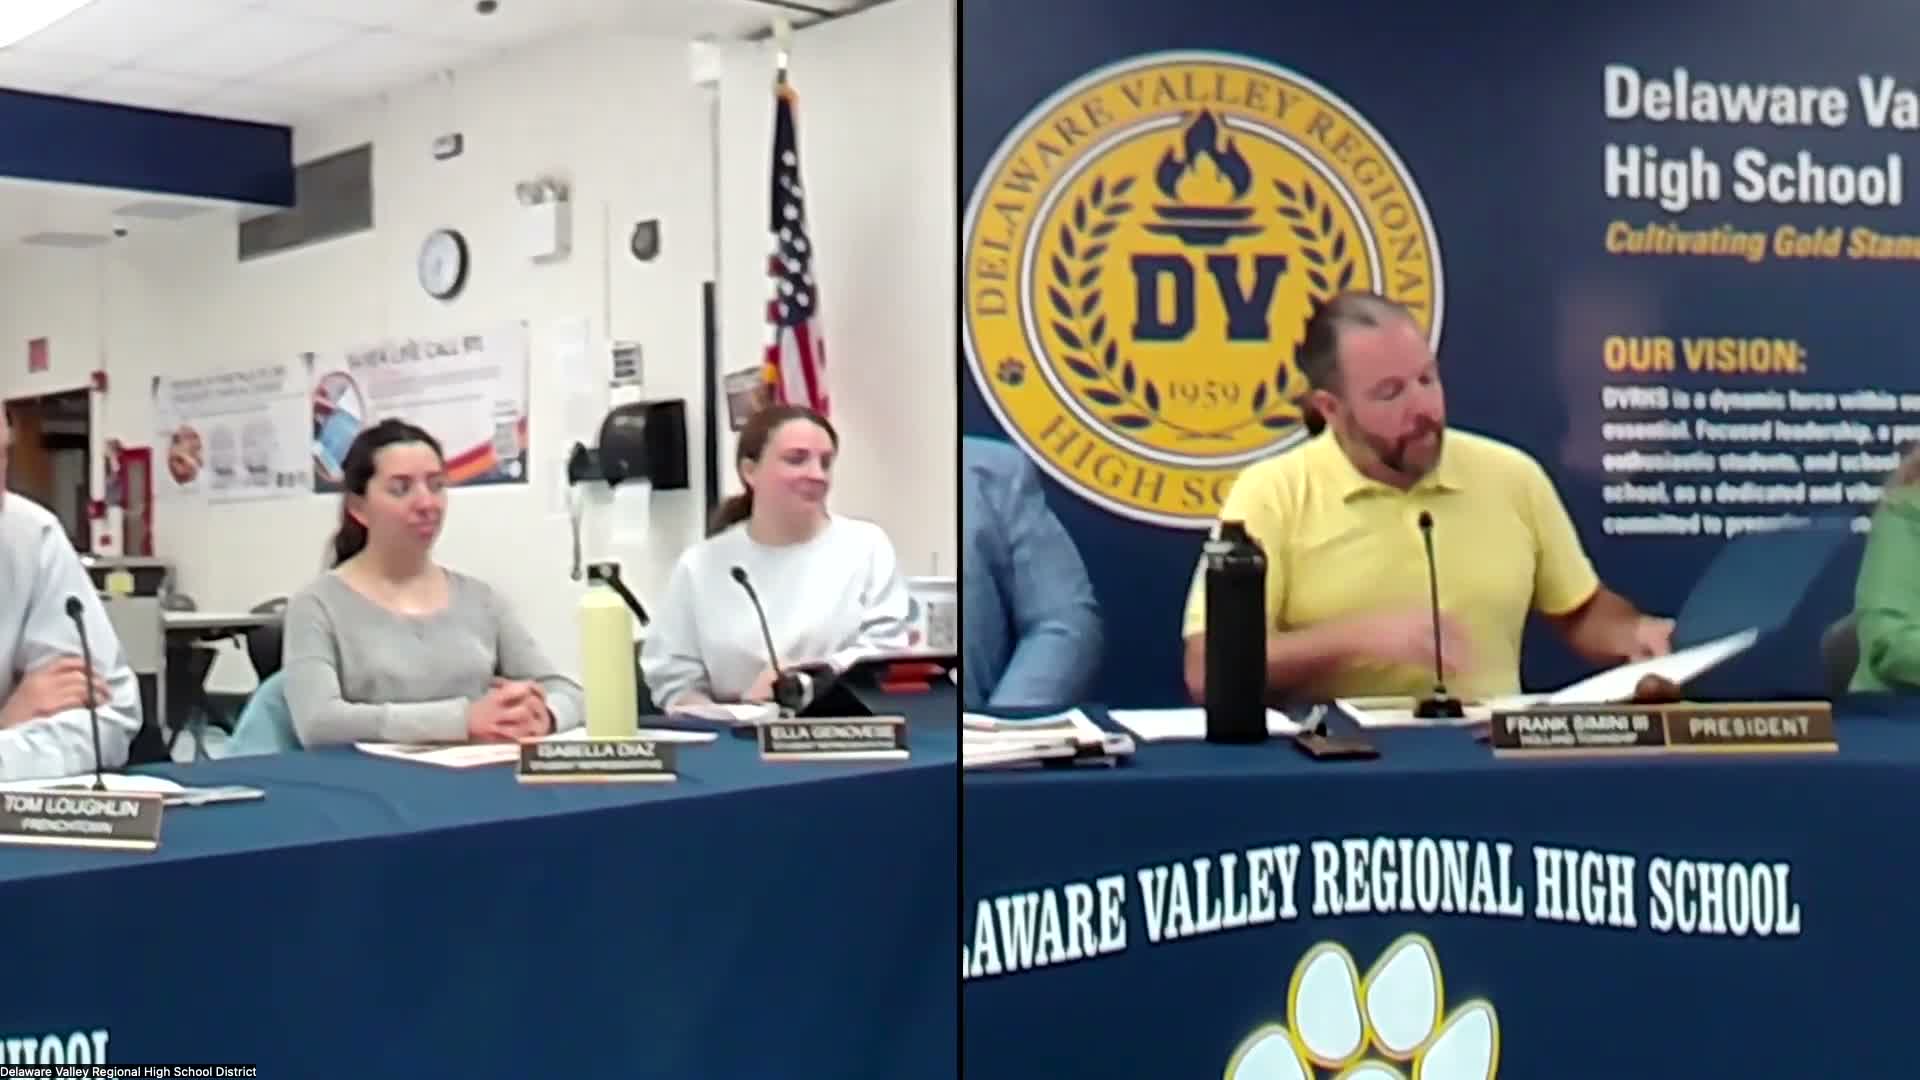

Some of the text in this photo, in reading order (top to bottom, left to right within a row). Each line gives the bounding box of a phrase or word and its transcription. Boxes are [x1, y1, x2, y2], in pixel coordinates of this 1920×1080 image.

[1604, 64, 1848, 128] Delaware
[978, 98, 1114, 317] DELAWARE
[1121, 71, 1299, 119] VALLEY
[1604, 144, 1902, 213] High School
[1605, 220, 1767, 263] Cultivating
[1773, 224, 1844, 259] Gold
[1130, 254, 1289, 342] DV
[1604, 336, 1807, 374] OUR VISION:
[1168, 380, 1241, 410] 1959
[1041, 415, 1167, 504] HIGH
[770, 724, 811, 741] ELLA
[1506, 714, 1569, 734] FRANK
[1688, 716, 1810, 738] PRESIDENT
[616, 741, 656, 758] DIAZ
[4, 794, 140, 817] TOM LOUGHLIN
[1136, 843, 1300, 944] VALLEY
[1310, 837, 1524, 919] REGIONAL
[1533, 845, 1638, 929] HIGH
[1648, 858, 1801, 938] SCHOOL
